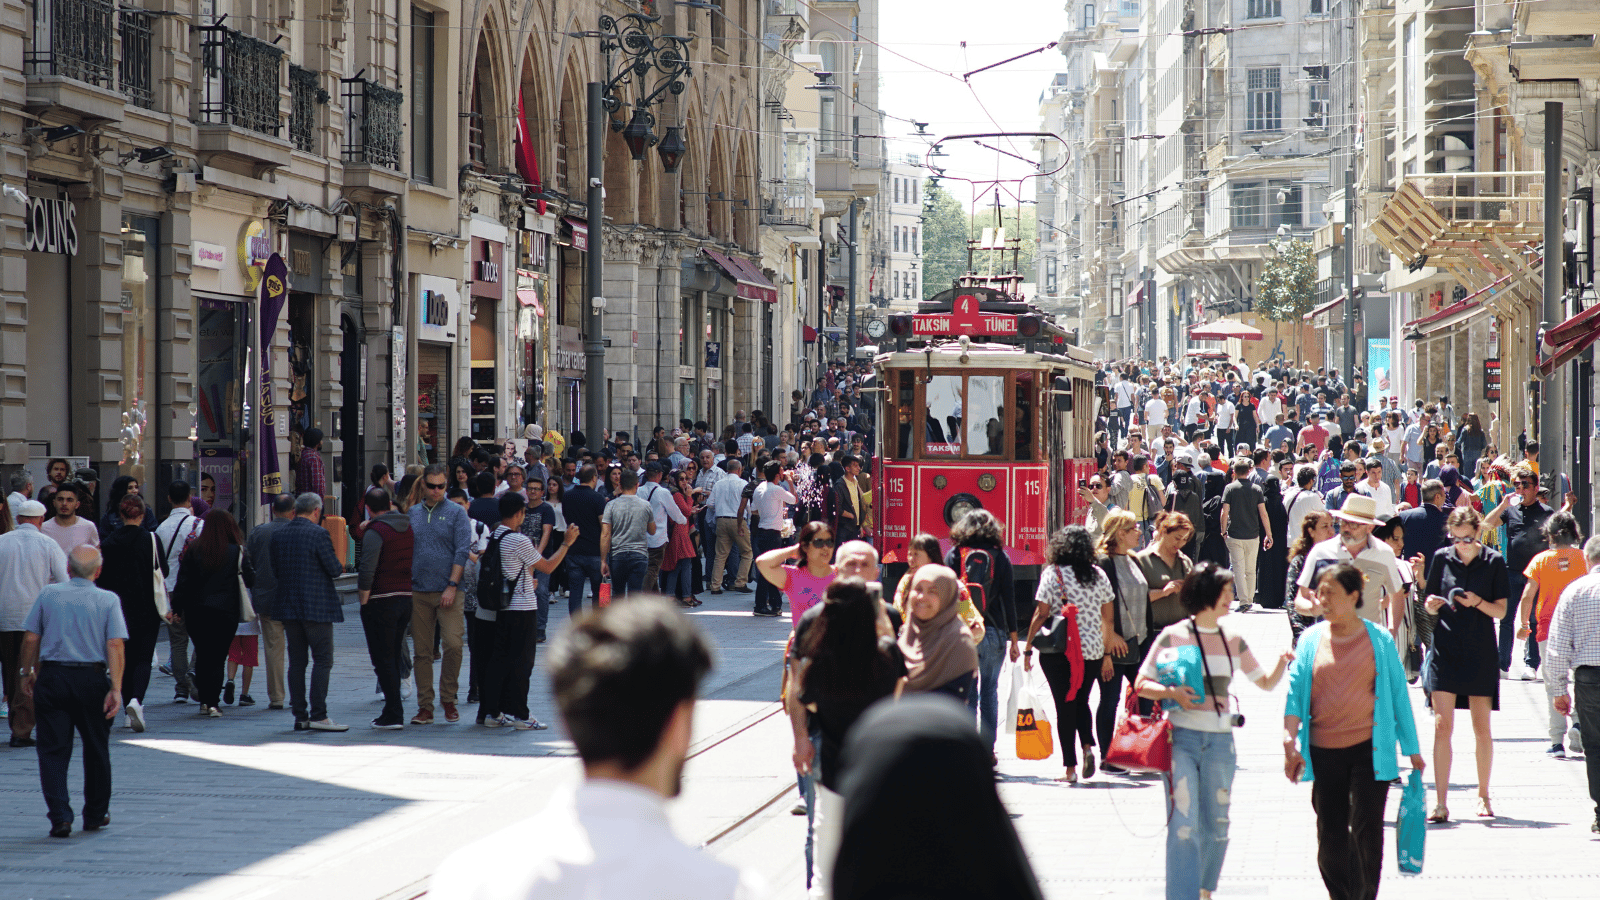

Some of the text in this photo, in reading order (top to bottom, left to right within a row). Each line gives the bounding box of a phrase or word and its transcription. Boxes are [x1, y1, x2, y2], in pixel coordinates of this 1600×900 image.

[961, 298, 969, 314] 4
[913, 316, 950, 332] TAKSİM
[984, 316, 1018, 332] TÜNEL
[889, 477, 904, 493] 115
[1024, 480, 1040, 496] 115
